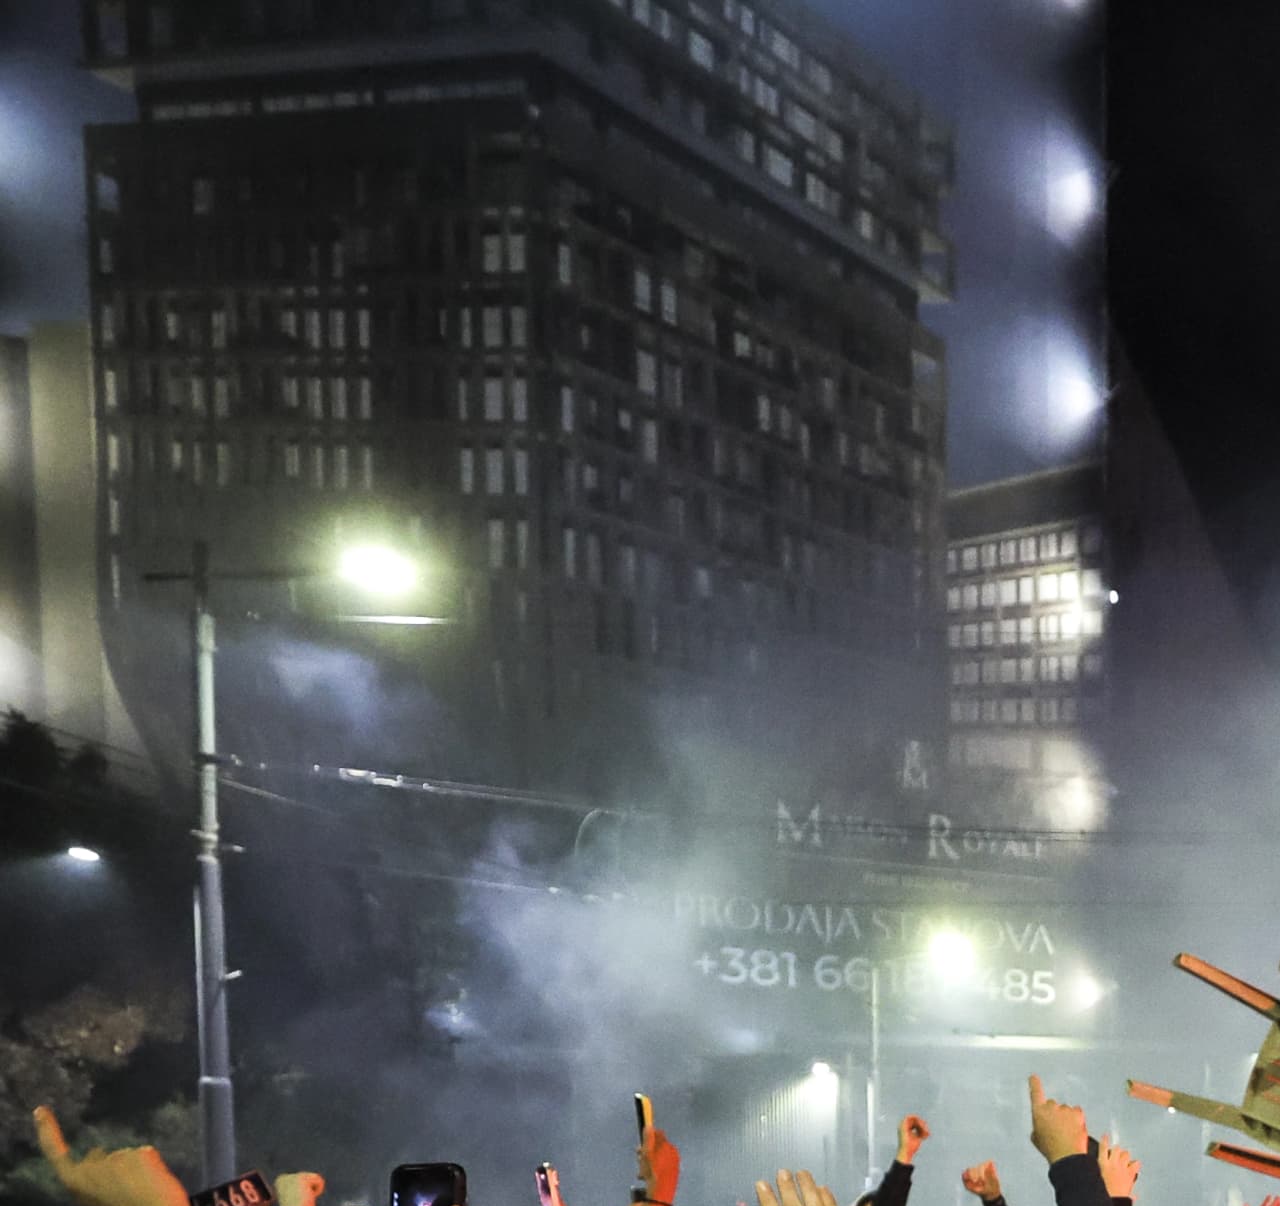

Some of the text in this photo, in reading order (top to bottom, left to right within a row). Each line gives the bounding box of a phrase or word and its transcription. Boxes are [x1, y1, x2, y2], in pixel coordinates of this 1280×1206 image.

[871, 908, 1056, 956] STAOVA
[693, 946, 797, 988] +381
[813, 954, 870, 992] 66
